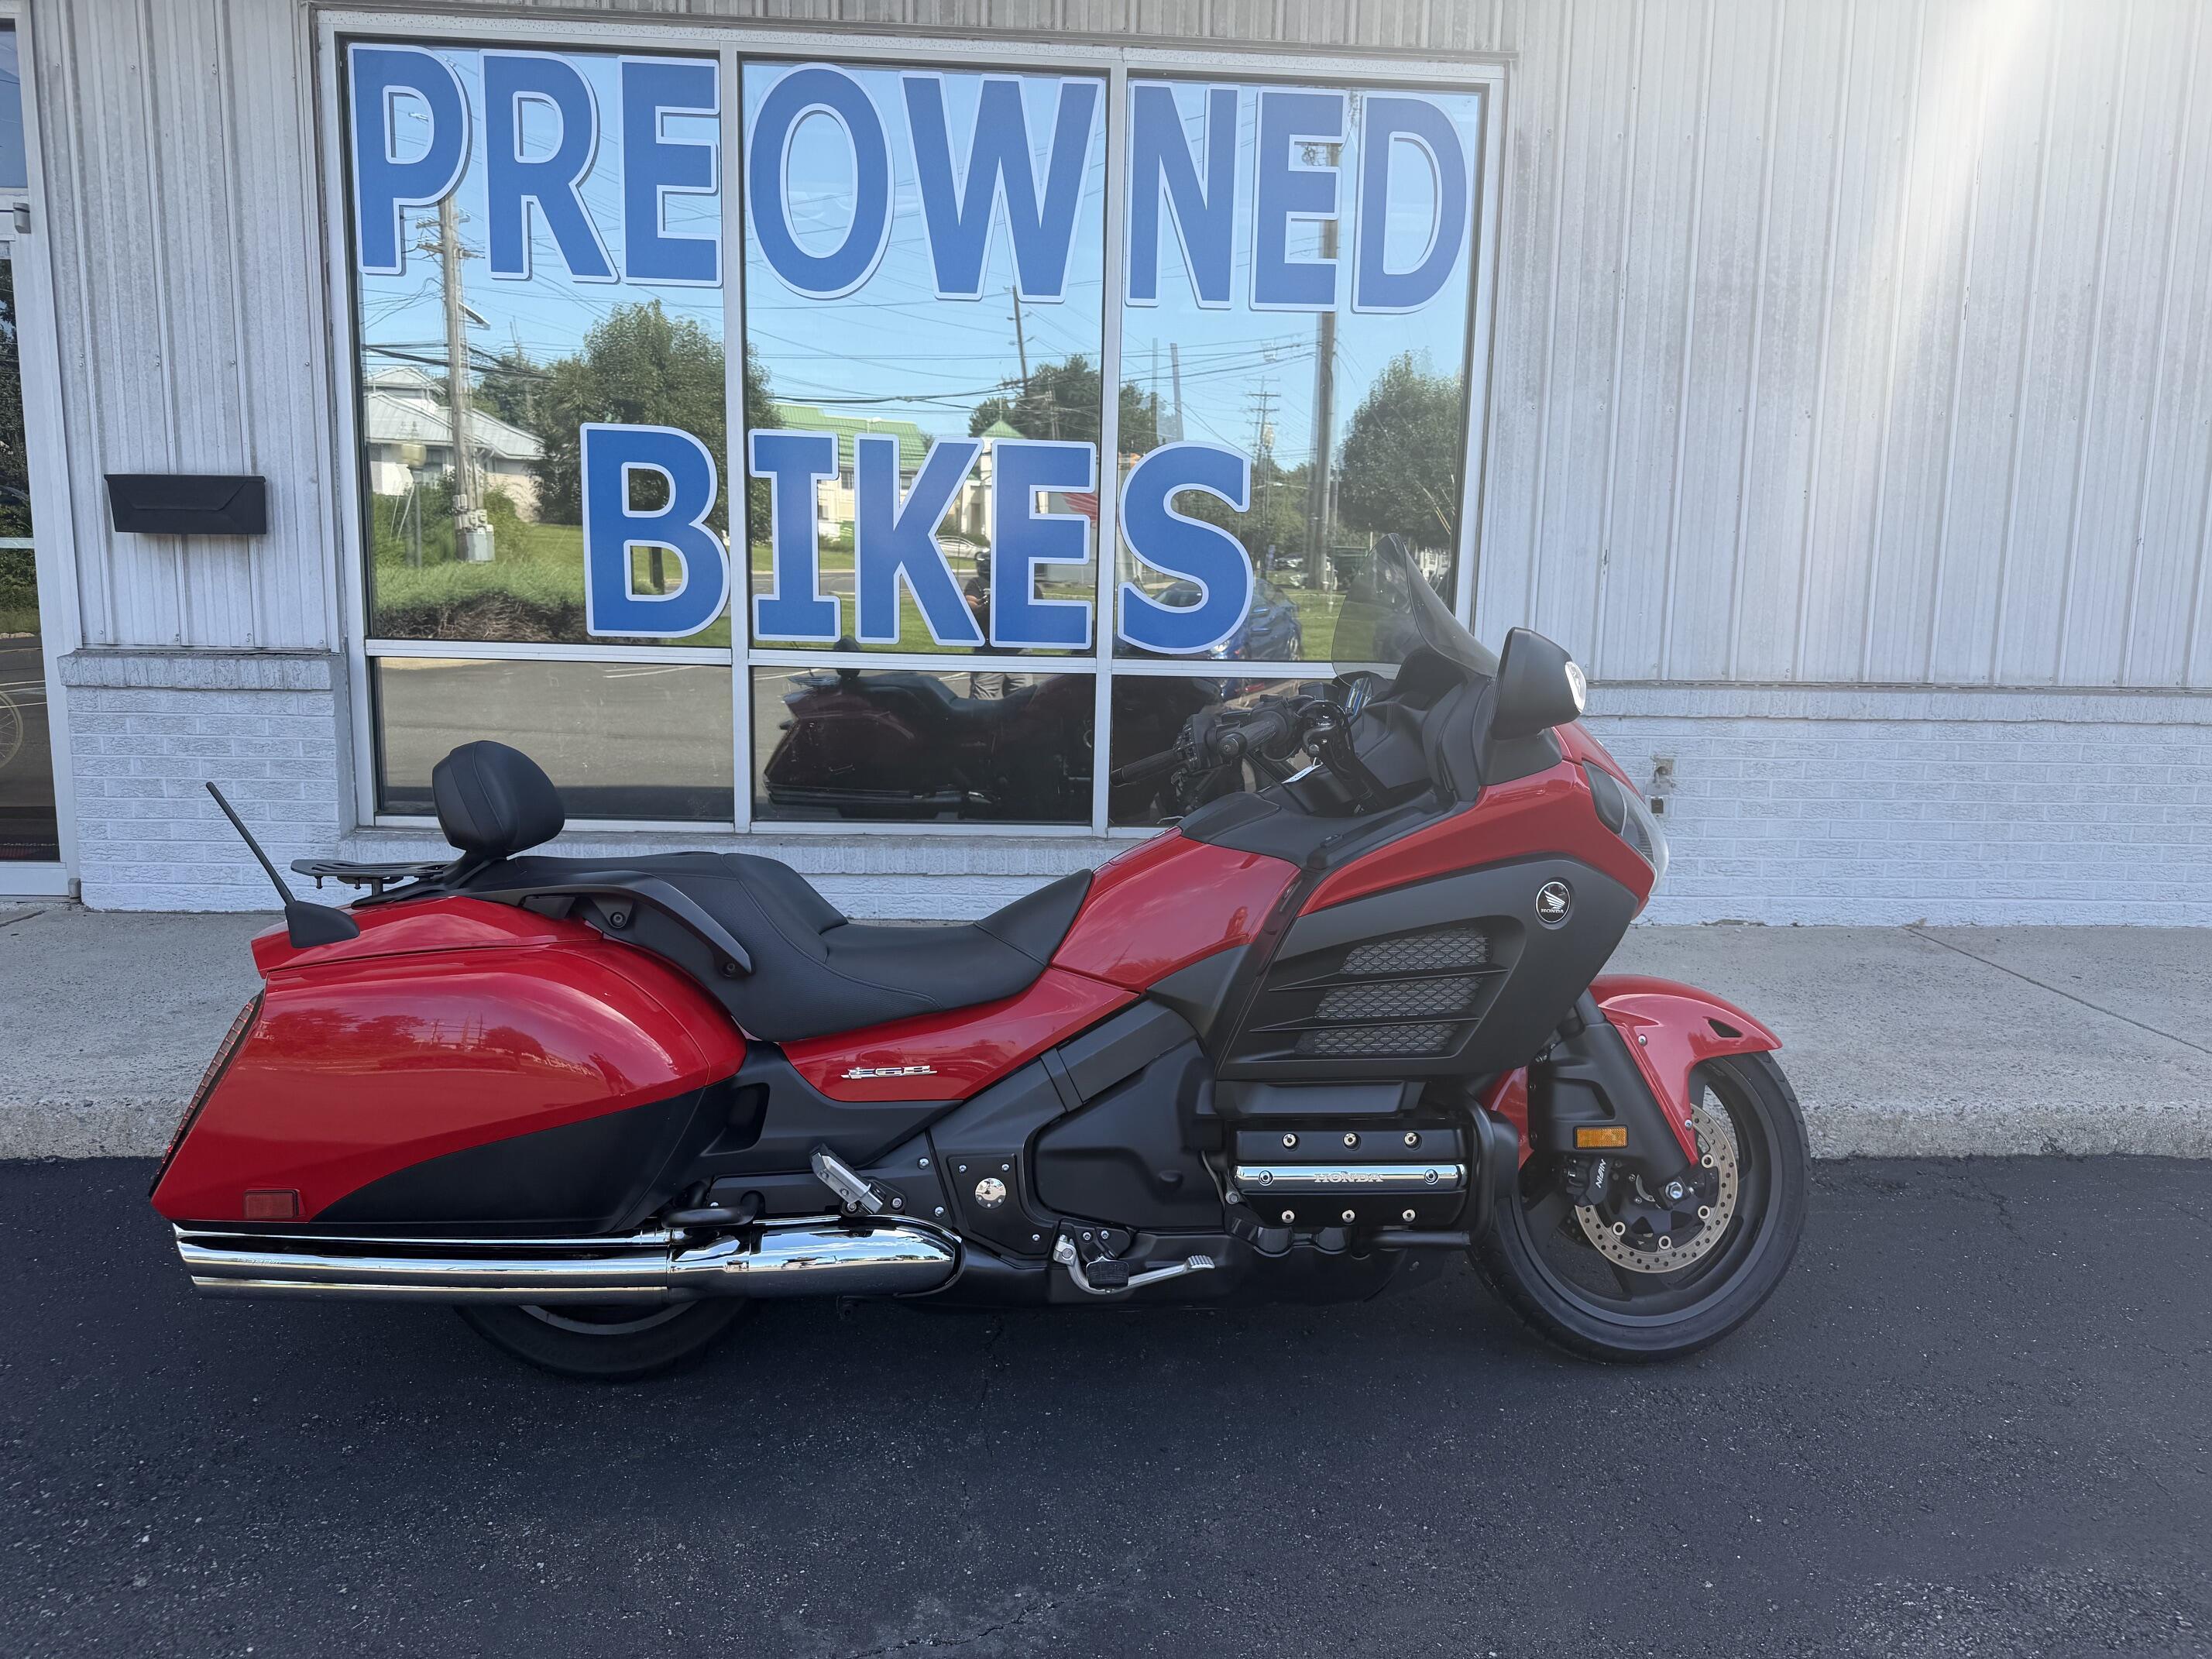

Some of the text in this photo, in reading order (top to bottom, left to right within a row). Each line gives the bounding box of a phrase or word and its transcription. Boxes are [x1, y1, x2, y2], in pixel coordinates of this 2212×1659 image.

[348, 43, 1467, 314] PREOWNED
[580, 421, 1254, 654] BIKES
[1314, 1172, 1384, 1183] HONDA
[1595, 1158, 1606, 1189] NISSIN
